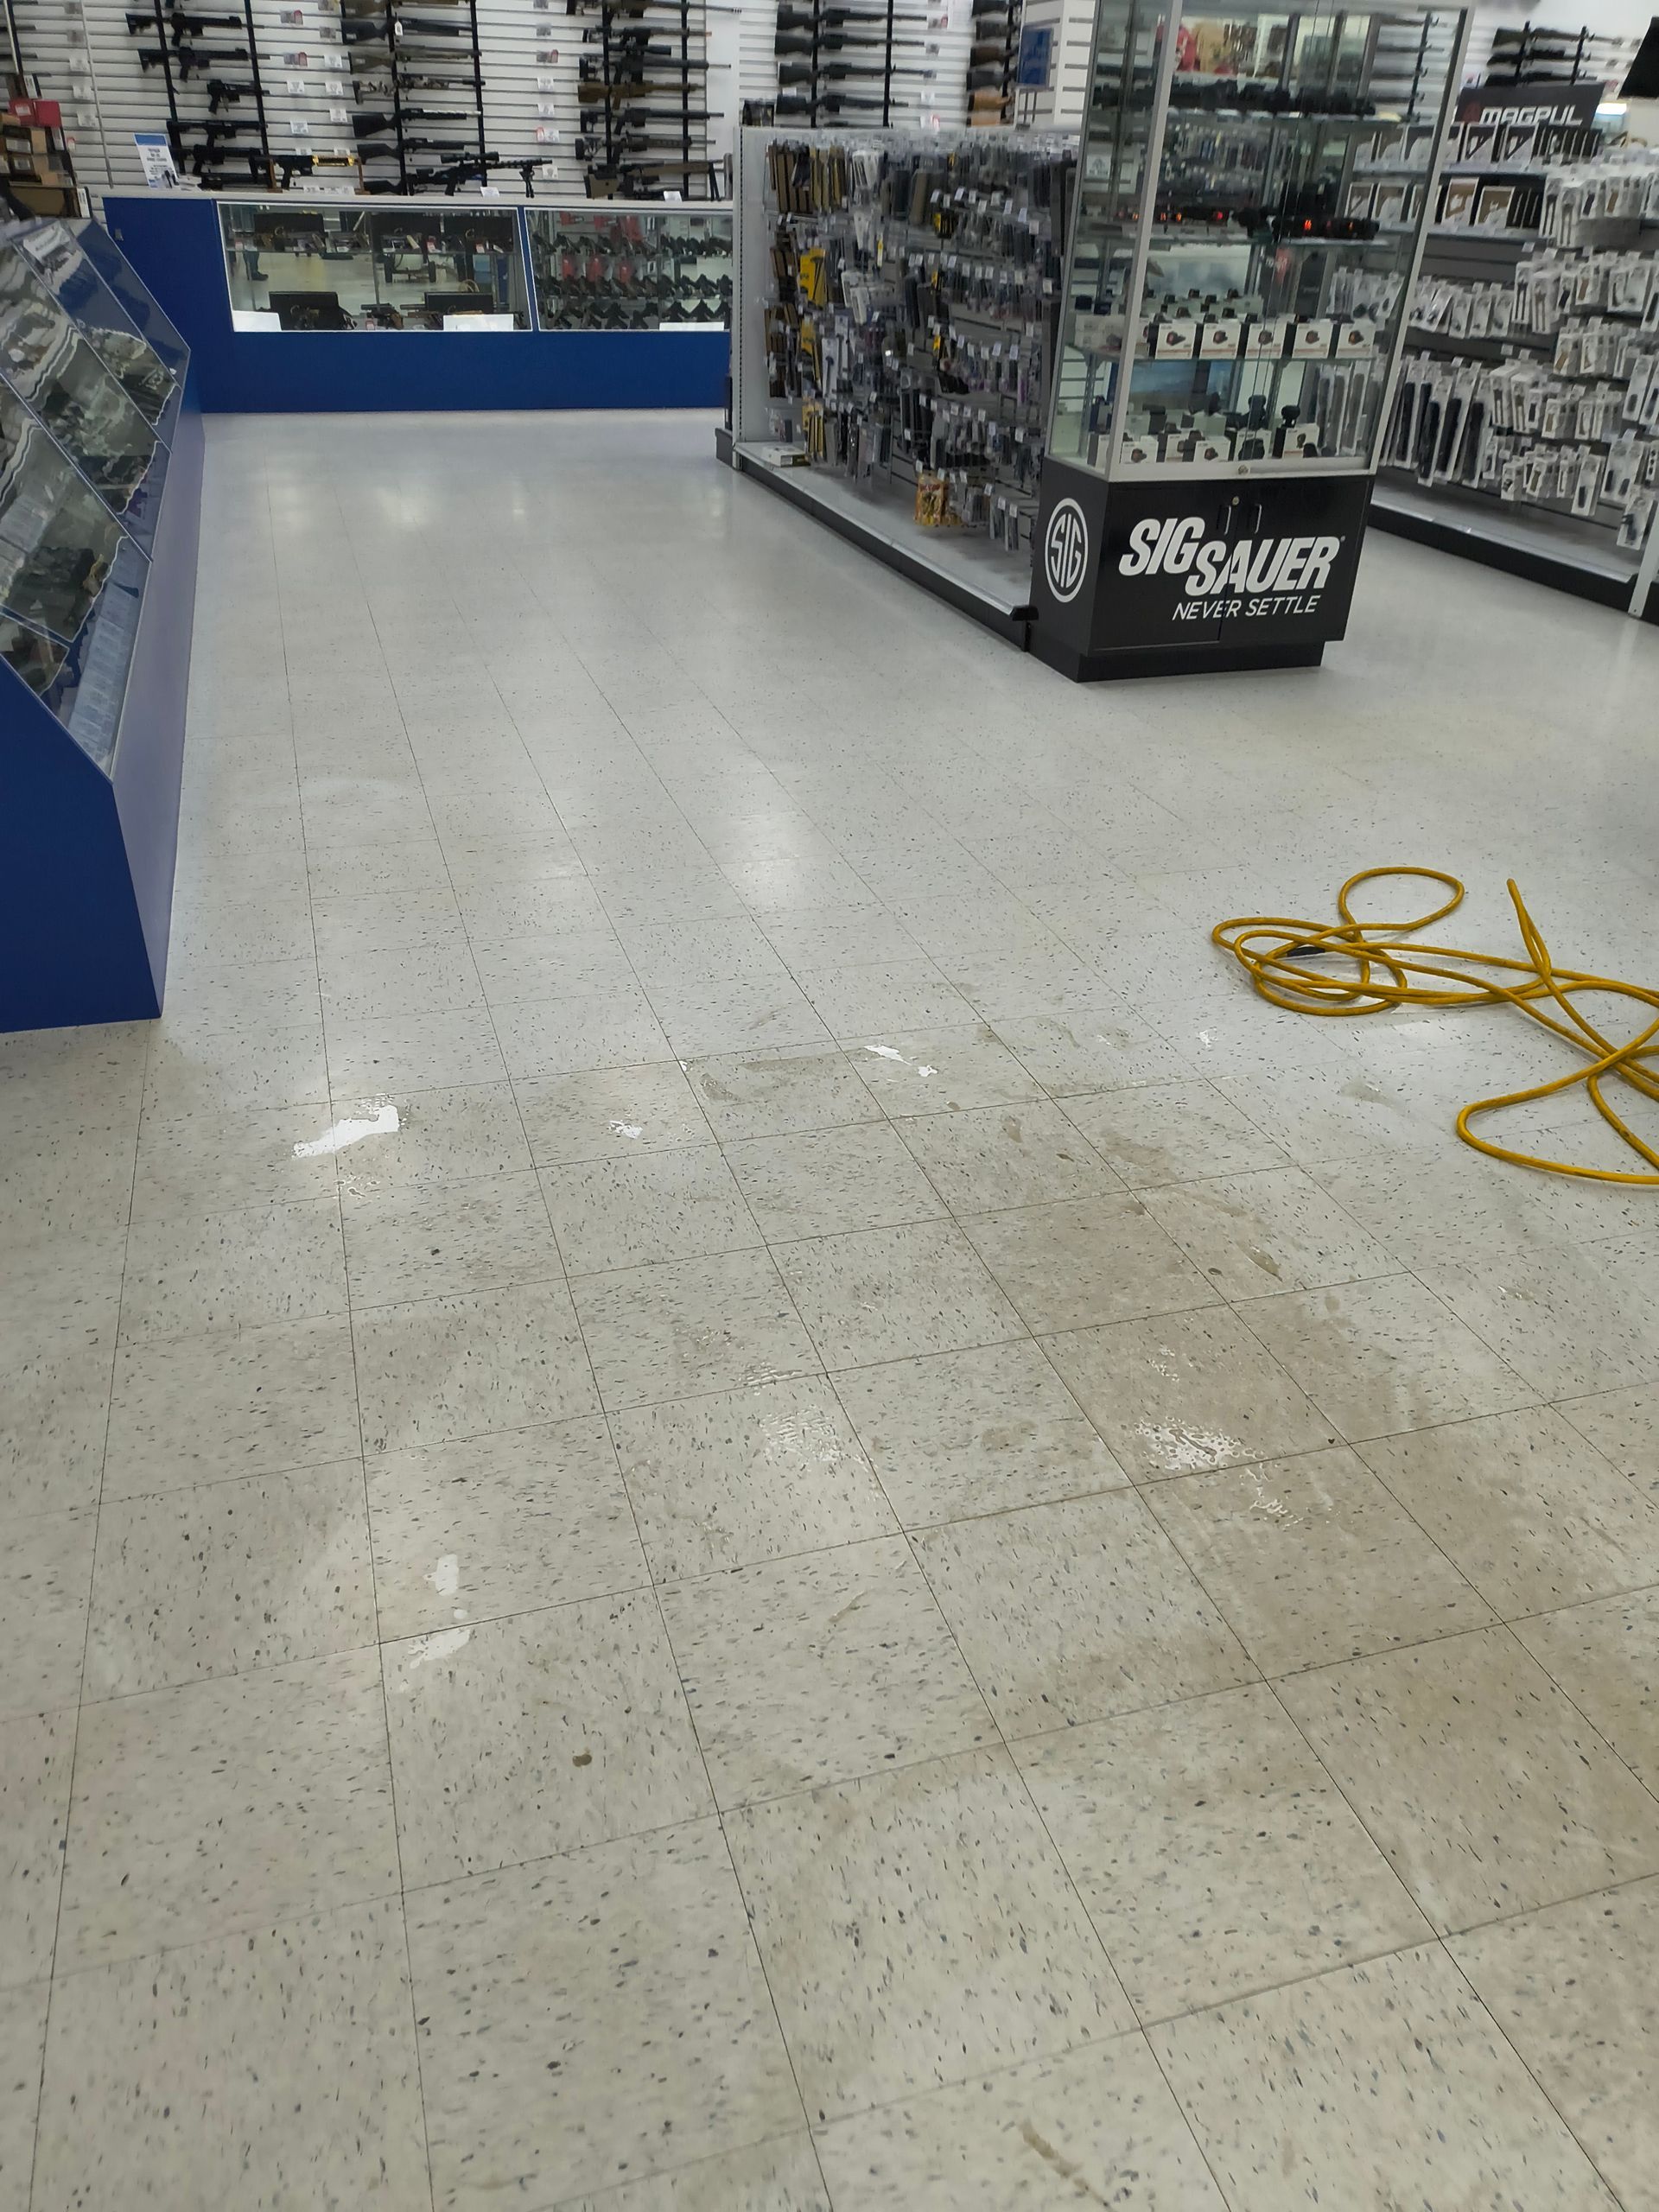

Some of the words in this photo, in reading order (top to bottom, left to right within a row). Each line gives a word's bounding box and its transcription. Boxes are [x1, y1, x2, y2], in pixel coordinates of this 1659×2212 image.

[1478, 104, 1583, 126] MAGPUL
[1050, 511, 1083, 590] SIG
[1118, 516, 1205, 576] SIG
[1185, 536, 1340, 596] SAUER
[1172, 600, 1242, 621] NEVER
[1245, 594, 1322, 616] SETTLE
